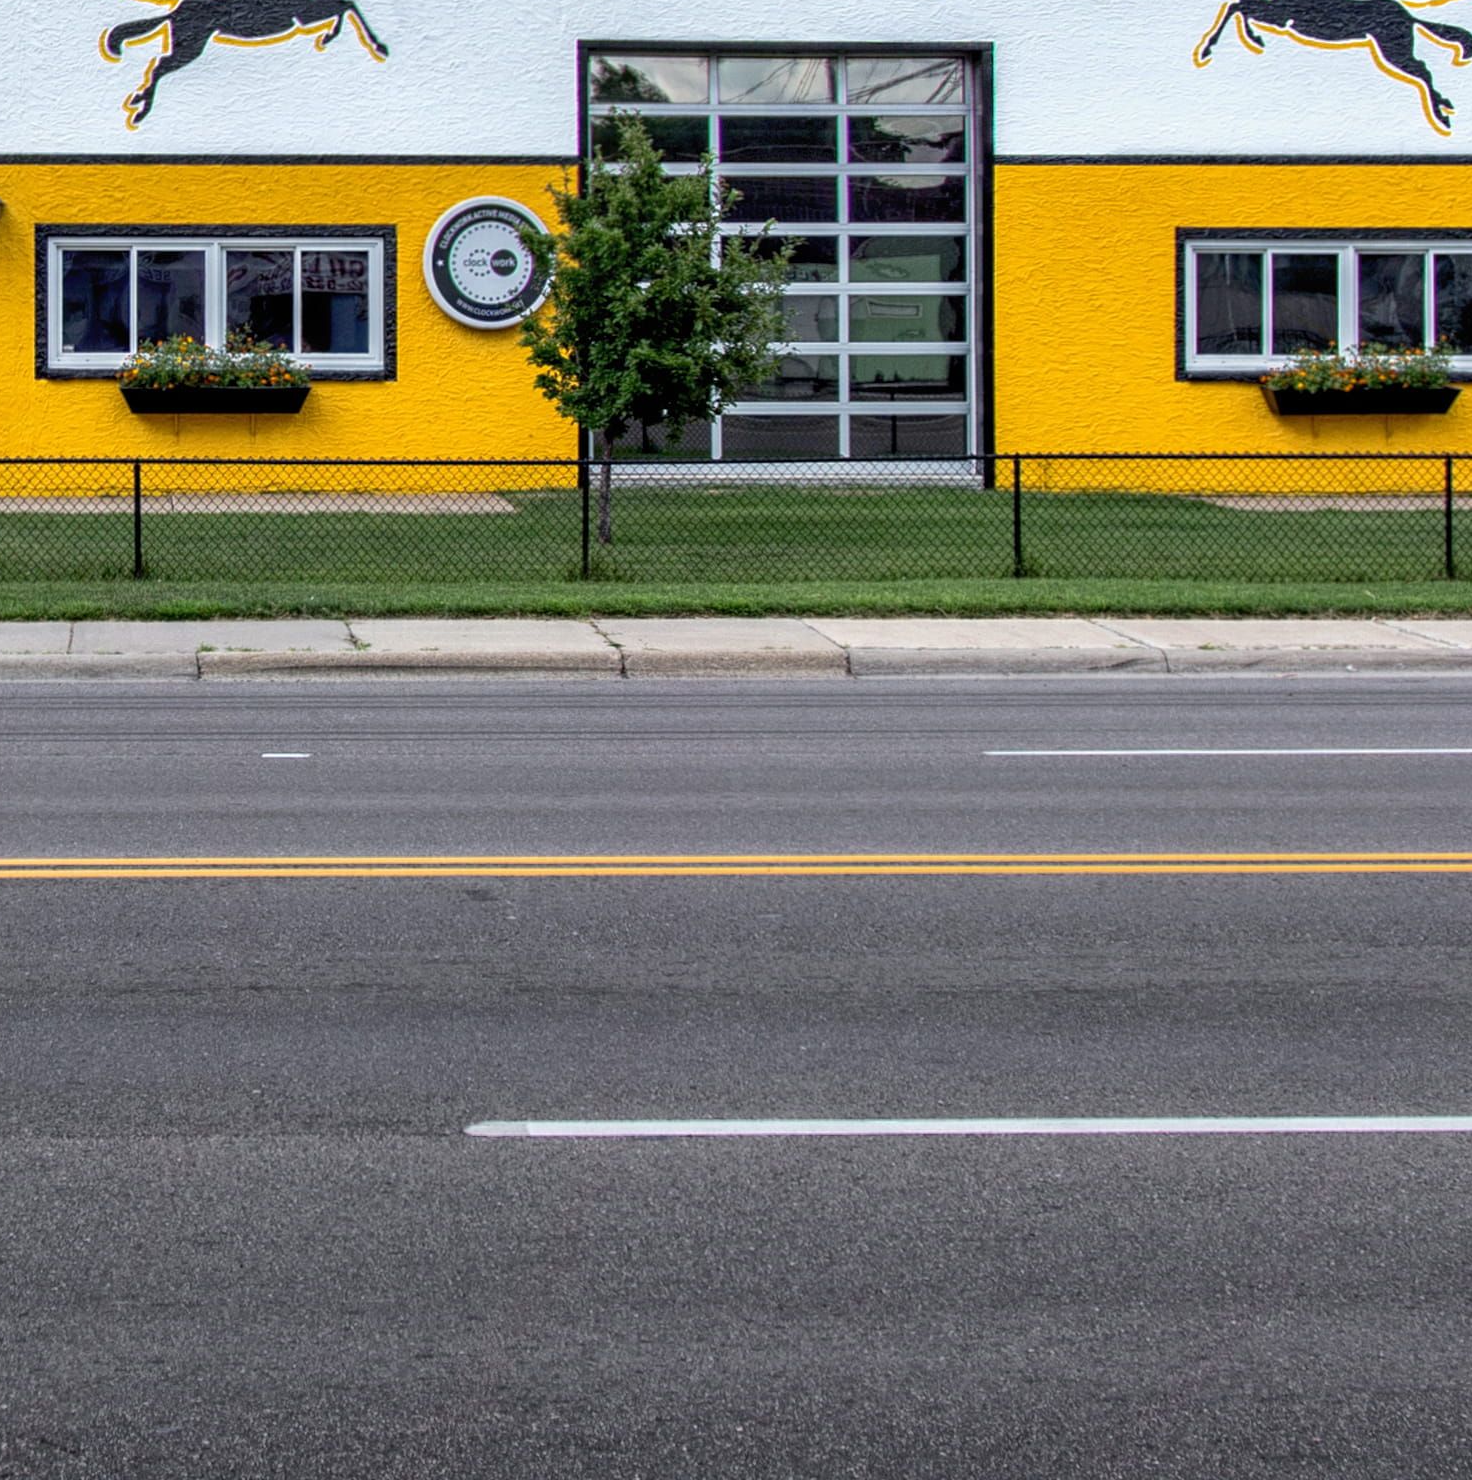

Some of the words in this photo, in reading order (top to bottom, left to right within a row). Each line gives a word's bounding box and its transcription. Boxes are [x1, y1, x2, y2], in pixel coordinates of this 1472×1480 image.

[440, 214, 472, 249] CLOCKWORK
[472, 209, 498, 220] ACTIVE
[498, 210, 522, 225] MEDIA
[463, 257, 488, 267] clock
[492, 257, 516, 267] work
